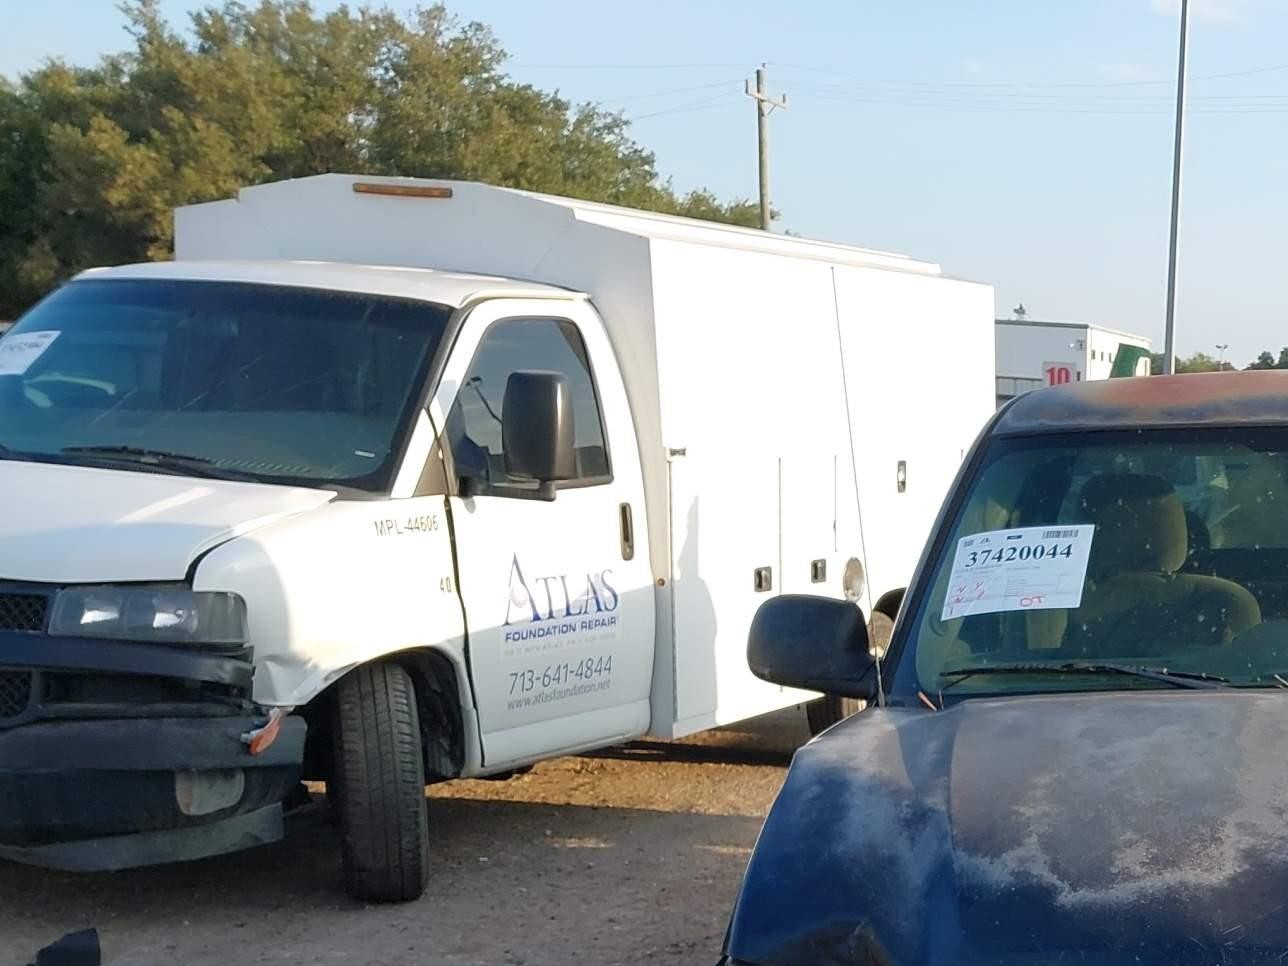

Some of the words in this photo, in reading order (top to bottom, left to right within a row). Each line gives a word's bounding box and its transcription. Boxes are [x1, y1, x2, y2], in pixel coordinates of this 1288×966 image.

[1046, 367, 1070, 385] 10
[964, 543, 1073, 568] 37420044
[502, 551, 619, 627] ATLAS
[504, 623, 577, 643] FOUNDATION
[580, 617, 617, 631] REPAIR
[509, 654, 613, 695] 713-641-4844
[506, 679, 611, 710] www.atlasfoundation.net
